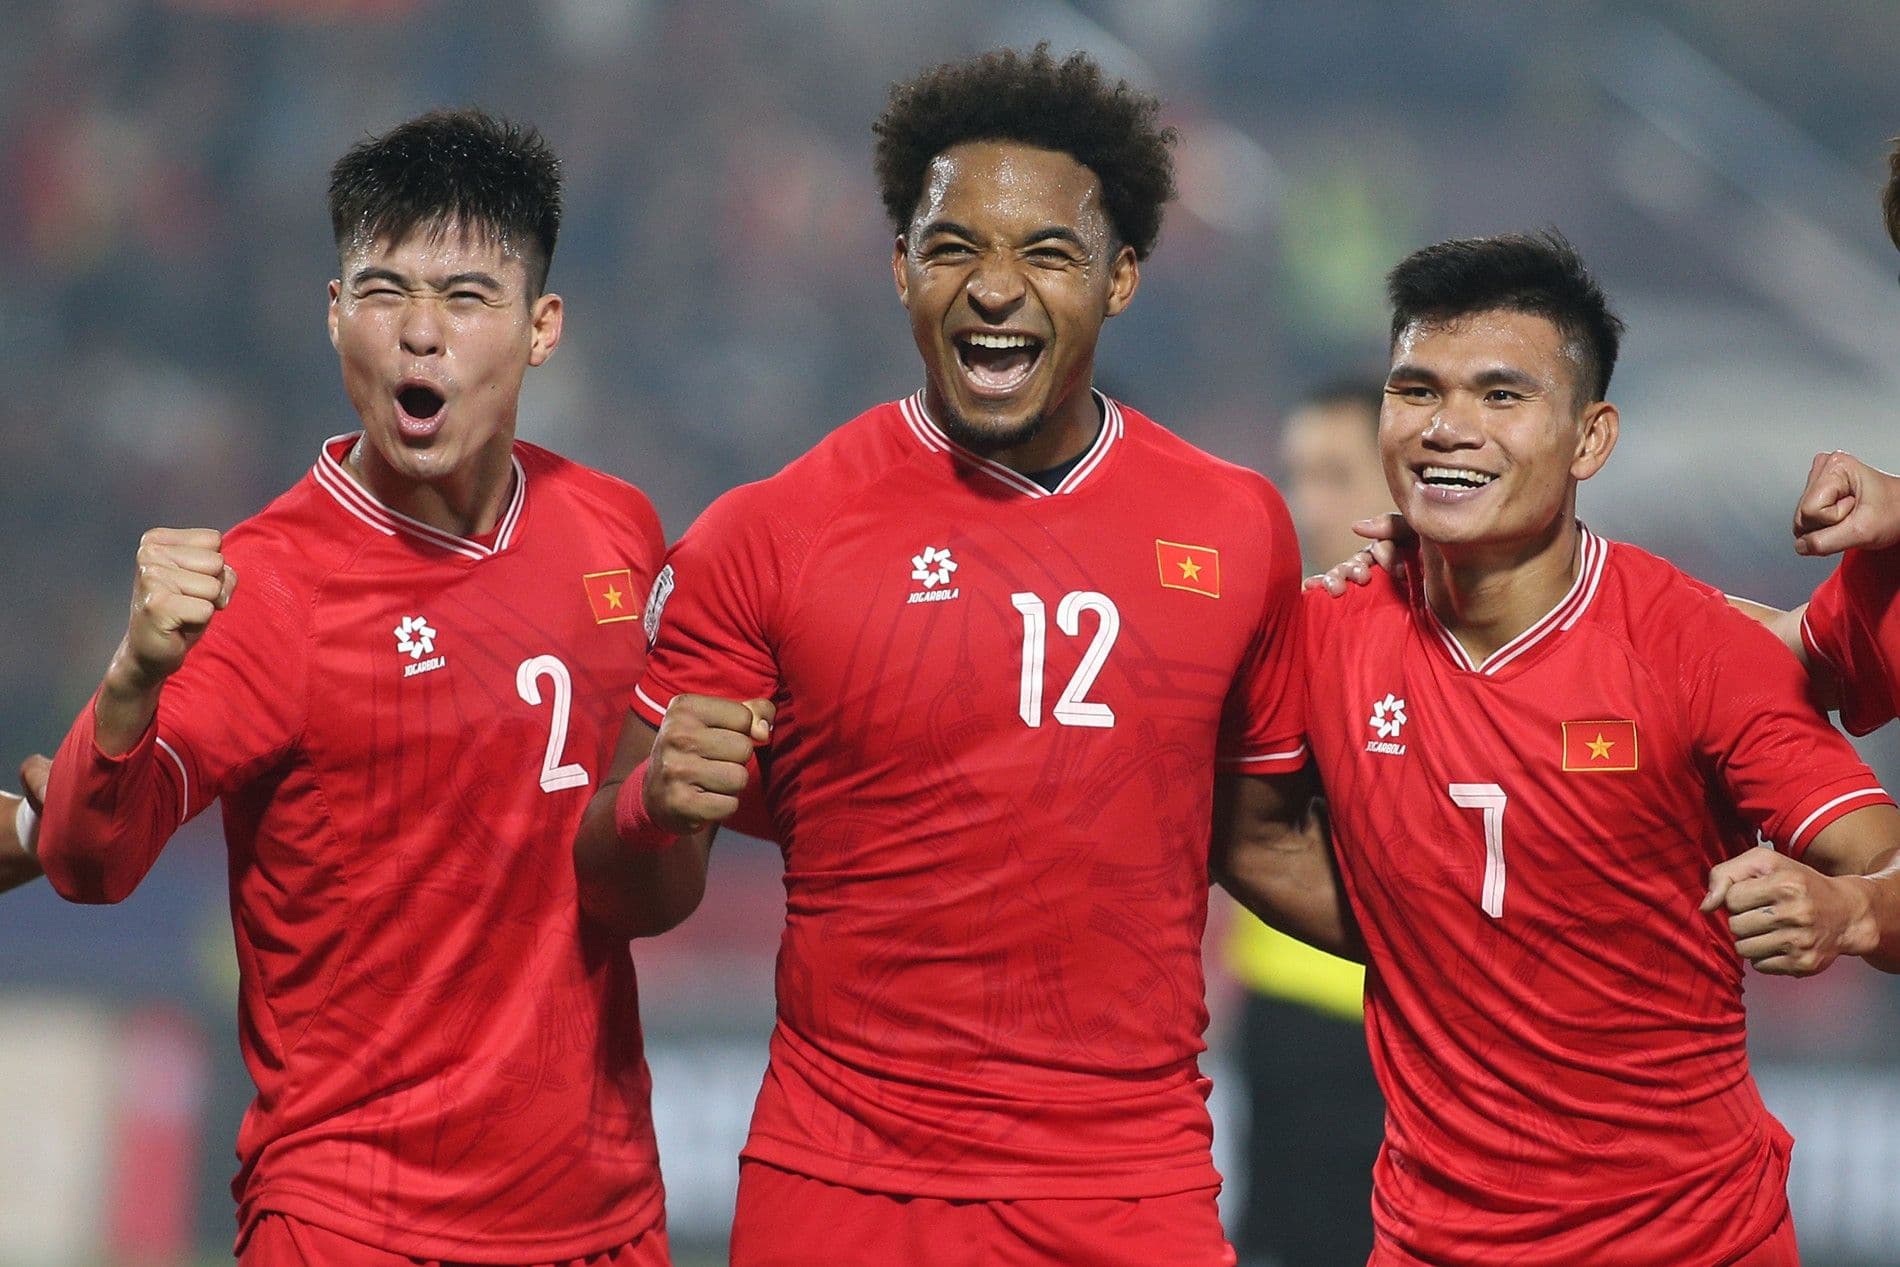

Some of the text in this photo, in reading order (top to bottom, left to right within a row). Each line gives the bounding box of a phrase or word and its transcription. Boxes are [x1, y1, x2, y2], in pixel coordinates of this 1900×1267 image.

[516, 654, 589, 793] 2
[1011, 591, 1119, 728] 12
[1449, 783, 1508, 918] 7
